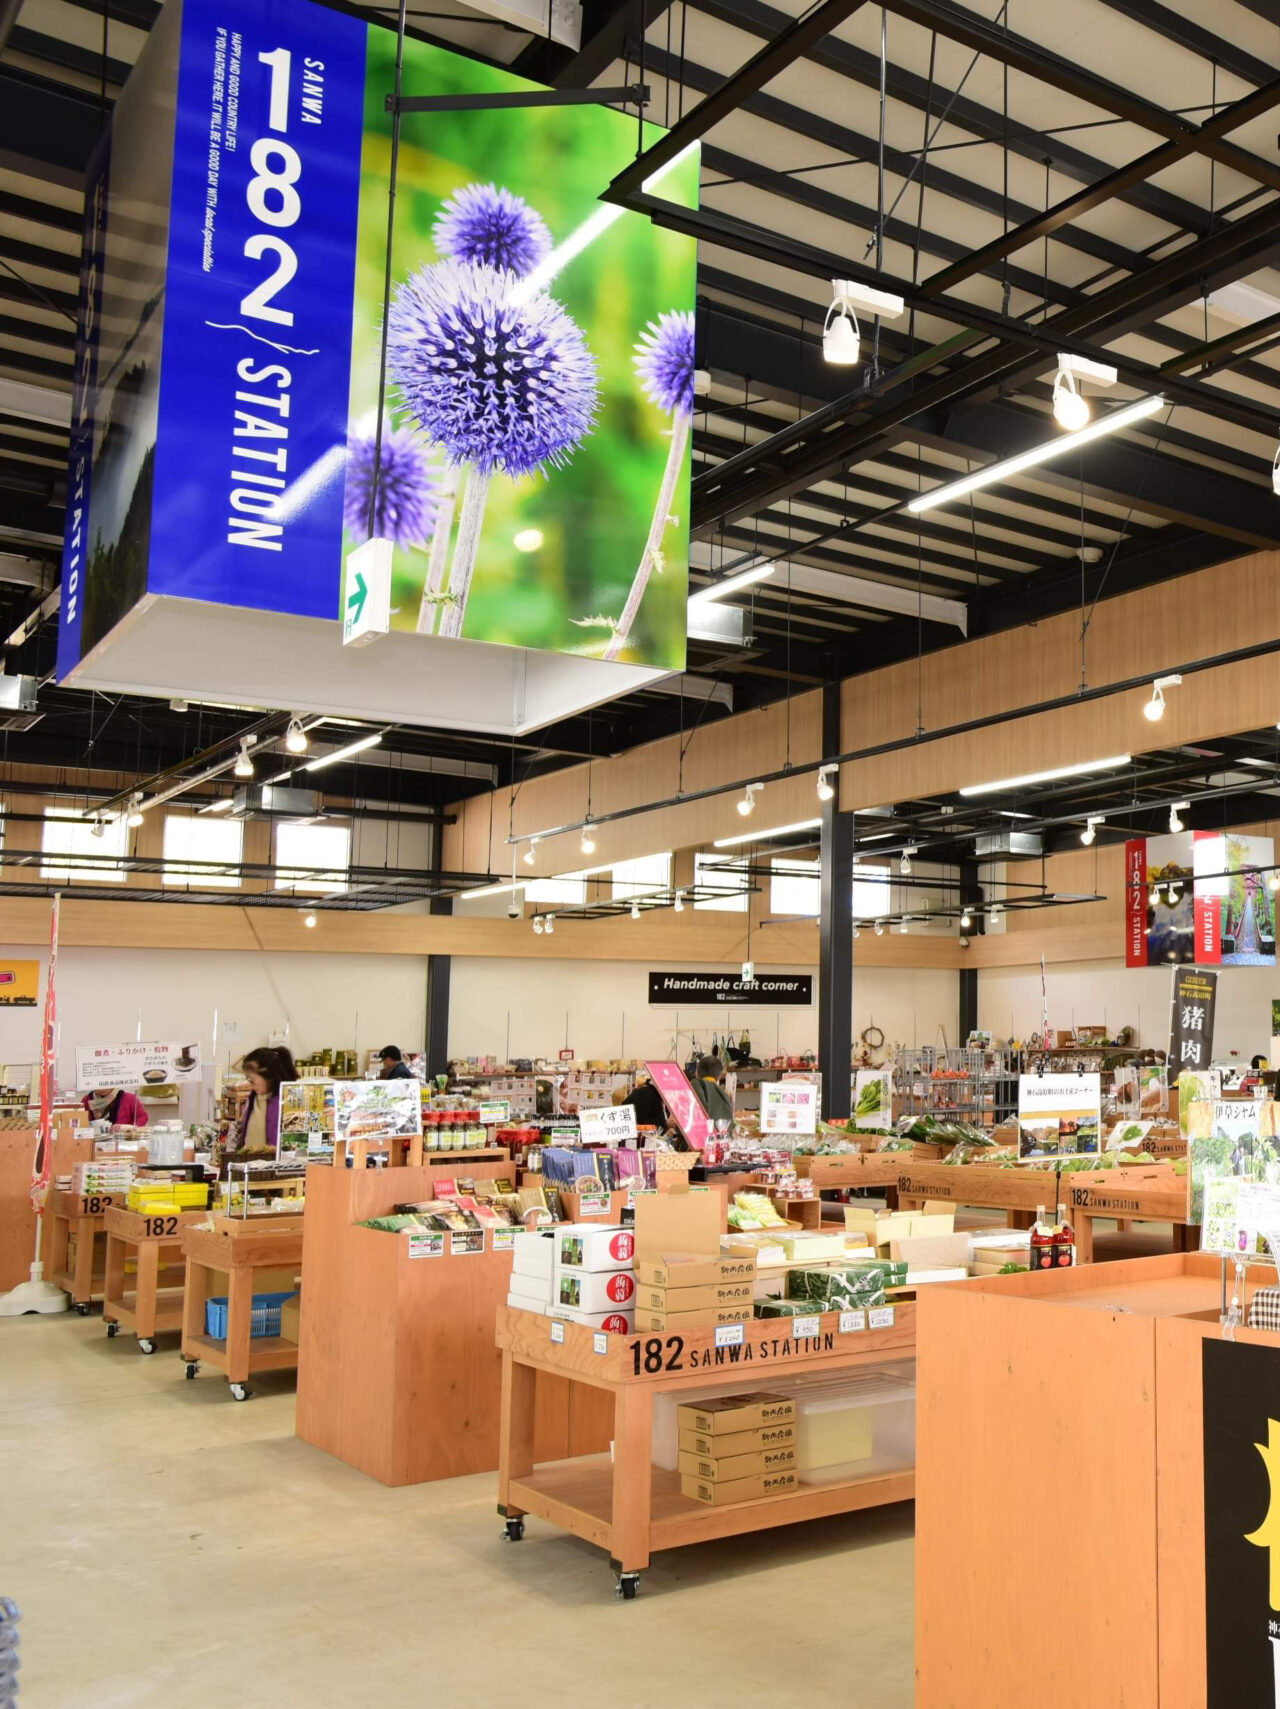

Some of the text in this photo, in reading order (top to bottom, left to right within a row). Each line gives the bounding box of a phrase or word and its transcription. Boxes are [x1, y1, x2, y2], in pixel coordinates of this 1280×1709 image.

[216, 26, 228, 37] IF
[215, 36, 227, 52] YOU
[230, 32, 242, 59] HAPPY
[213, 51, 226, 82] GATHER
[229, 57, 241, 75] AND
[212, 81, 224, 103] HERE
[228, 74, 240, 96] GOOD
[301, 57, 325, 124] SANWA
[211, 102, 223, 113] IT
[226, 96, 239, 131] COUNTRY
[210, 111, 222, 130] WILL
[209, 130, 221, 143] BE
[208, 150, 220, 171] GOOD
[207, 170, 219, 187] DAY
[206, 187, 218, 208] WITH
[227, 47, 302, 551] 182 STATION
[66, 455, 86, 625] STATION
[1133, 917, 1141, 957] STATION
[1203, 910, 1214, 953] STATION
[663, 977, 800, 991] Handmade craft corner
[1181, 1005, 1205, 1065] 猪肉
[600, 1108, 632, 1122] くず湯
[606, 1126, 631, 1136] 700円
[1142, 1142, 1157, 1153] 182
[898, 1177, 912, 1193] 182
[1072, 1189, 1140, 1211] 182 SANWA STATION
[144, 1217, 178, 1237] 182
[630, 1333, 835, 1376] 182 SANWA STATION
